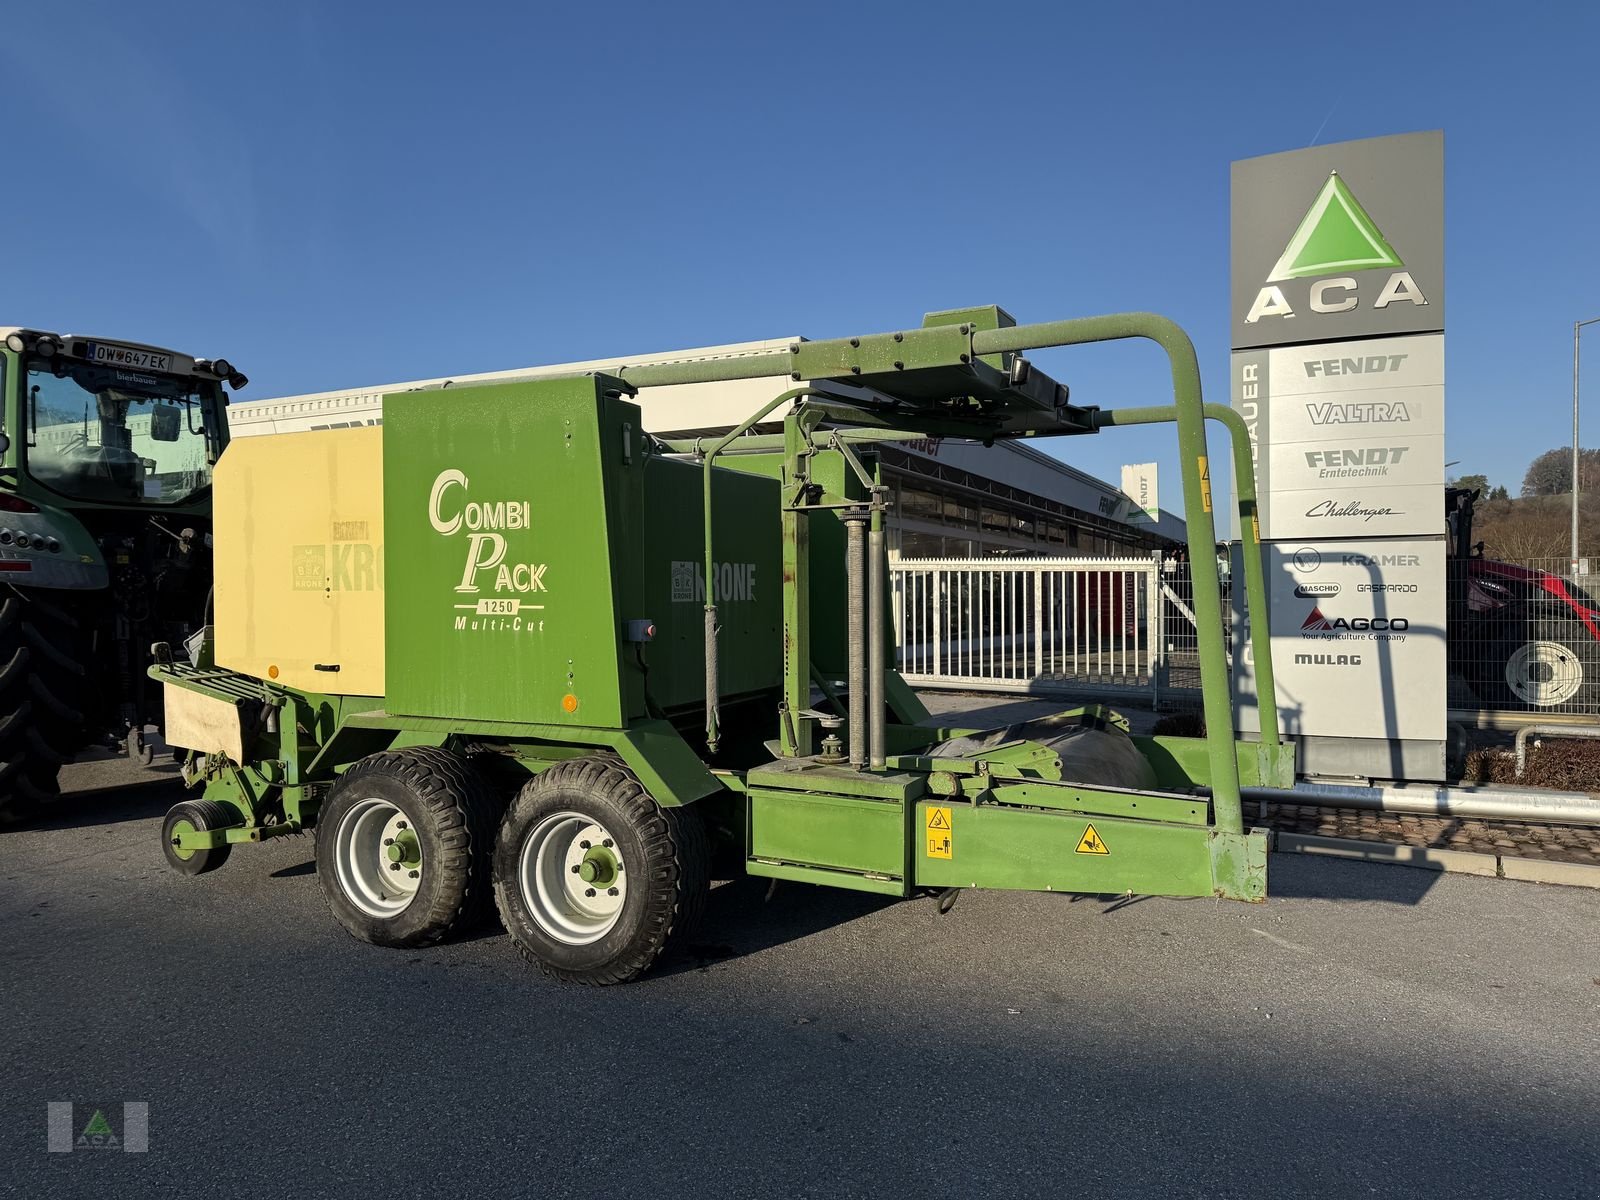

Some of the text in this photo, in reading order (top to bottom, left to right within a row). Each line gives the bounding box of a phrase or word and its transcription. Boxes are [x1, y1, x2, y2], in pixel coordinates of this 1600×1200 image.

[1244, 271, 1429, 324] ACA
[125, 351, 148, 365] 647
[150, 355, 166, 369] EK
[1303, 354, 1409, 378] FENDT
[116, 370, 157, 385] bierbauer
[1306, 402, 1410, 425] VALTRA
[1304, 447, 1409, 468] FENDT
[1318, 465, 1388, 479] Erntetechnik
[1305, 500, 1406, 522] Challenger
[1342, 555, 1420, 567] KRAMER
[1357, 584, 1418, 593] GASPARDO
[484, 601, 513, 613] 1250
[454, 616, 545, 632] Multi-Cut
[1333, 618, 1408, 631] AGCO
[1321, 633, 1366, 642] Agriculture
[1368, 633, 1406, 643] Company
